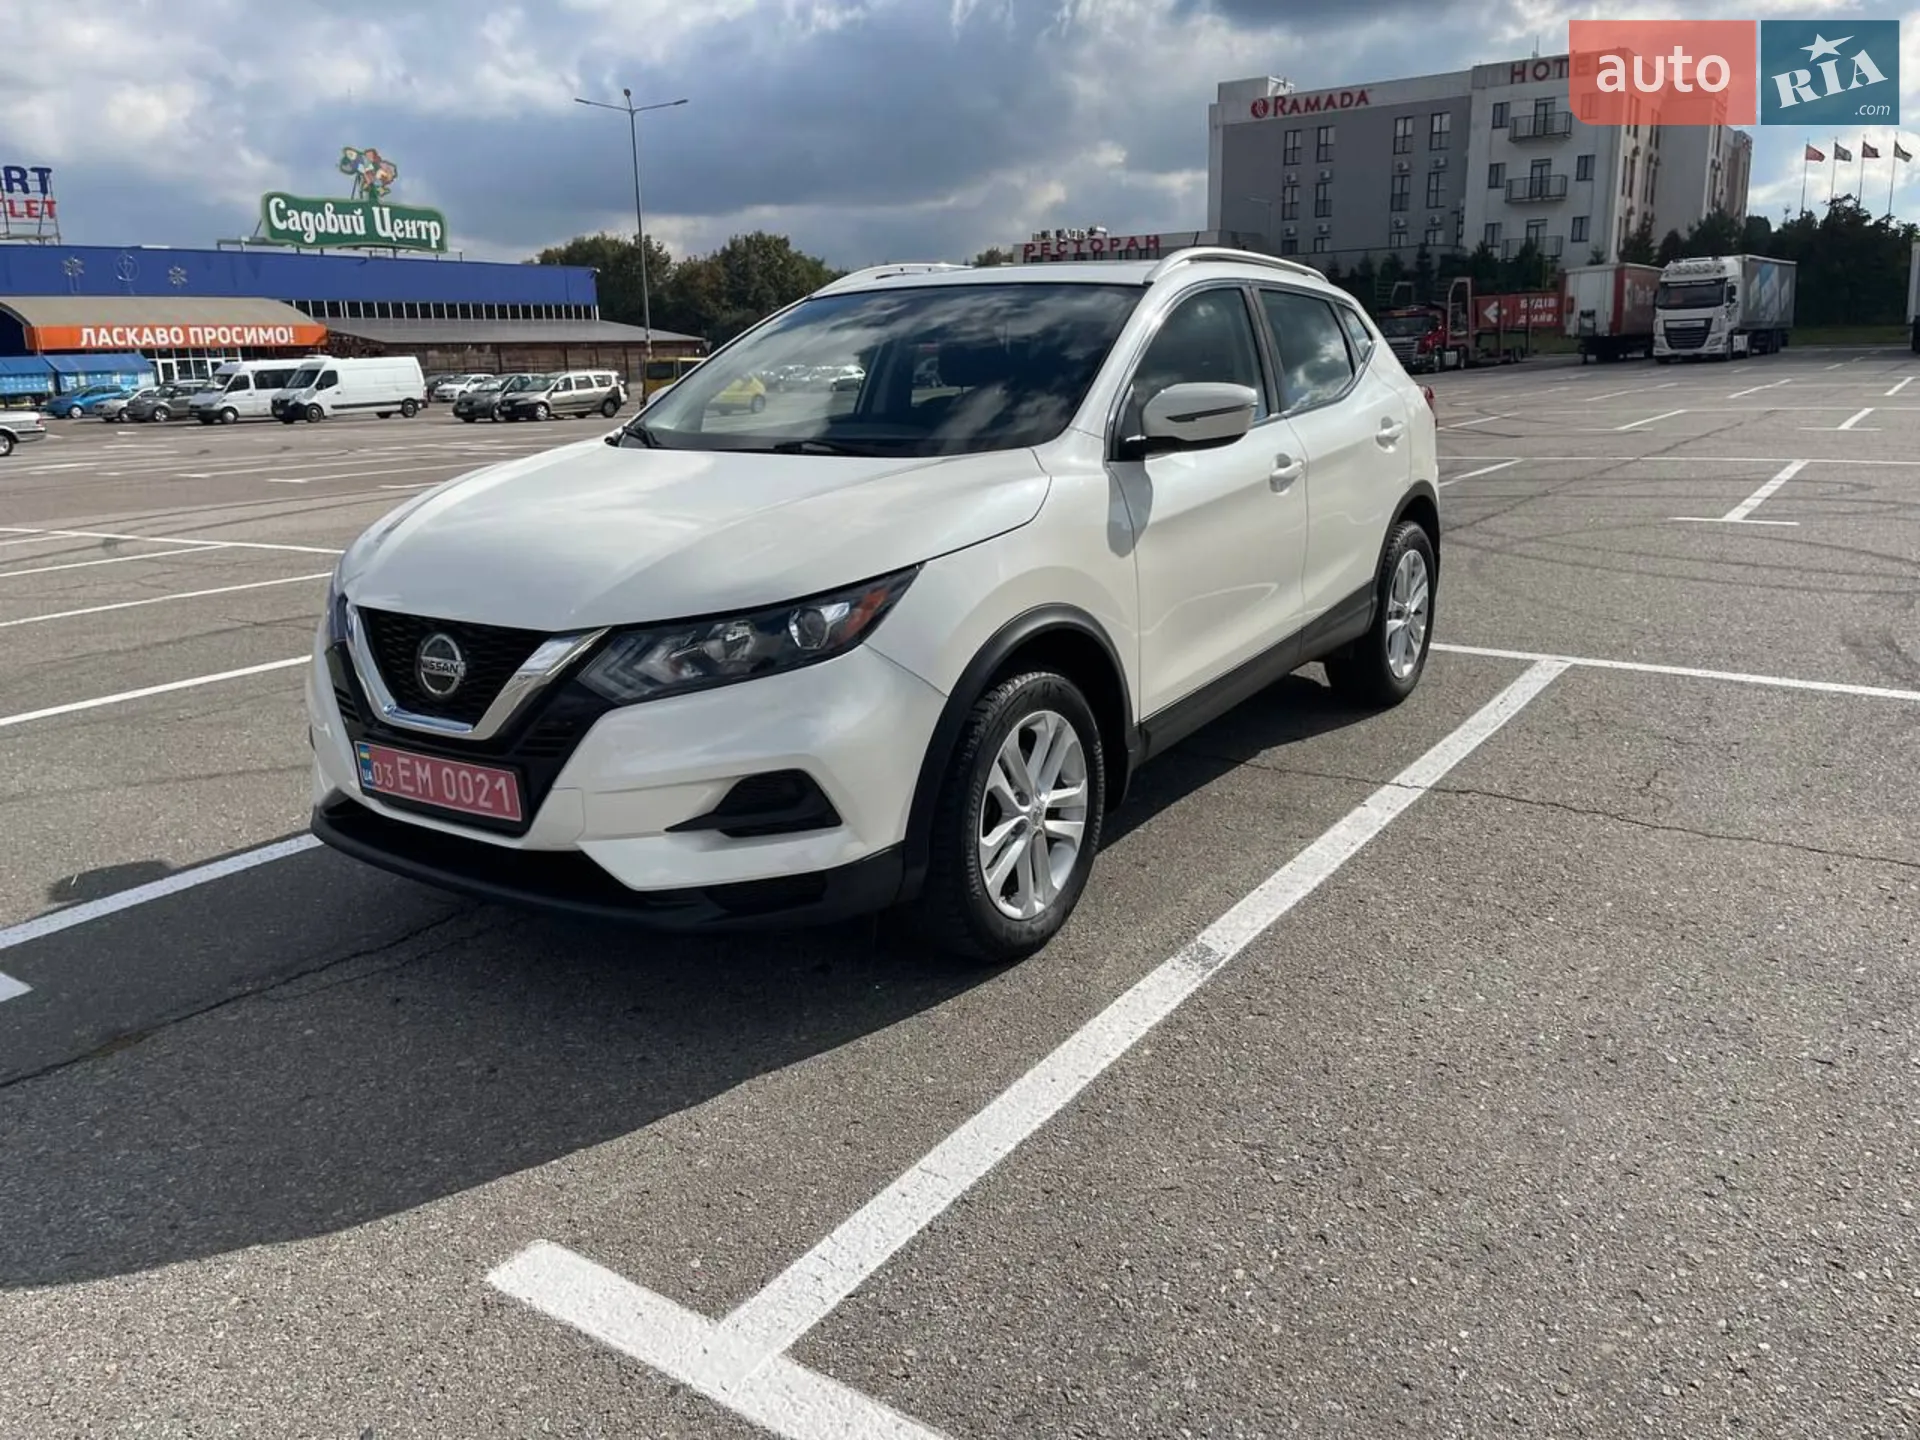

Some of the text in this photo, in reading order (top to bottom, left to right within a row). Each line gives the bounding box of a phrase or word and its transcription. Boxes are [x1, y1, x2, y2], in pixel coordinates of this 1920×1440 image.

[1273, 89, 1370, 117] RAMADA
[0, 198, 56, 219] LET
[269, 197, 441, 248] Садовий Центр
[1023, 234, 1160, 258] РЕСТОРАН
[80, 327, 295, 346] ЛАСКАВО ПРОСИМО!
[362, 768, 373, 782] UA
[372, 756, 511, 812] 03 EM 0021
